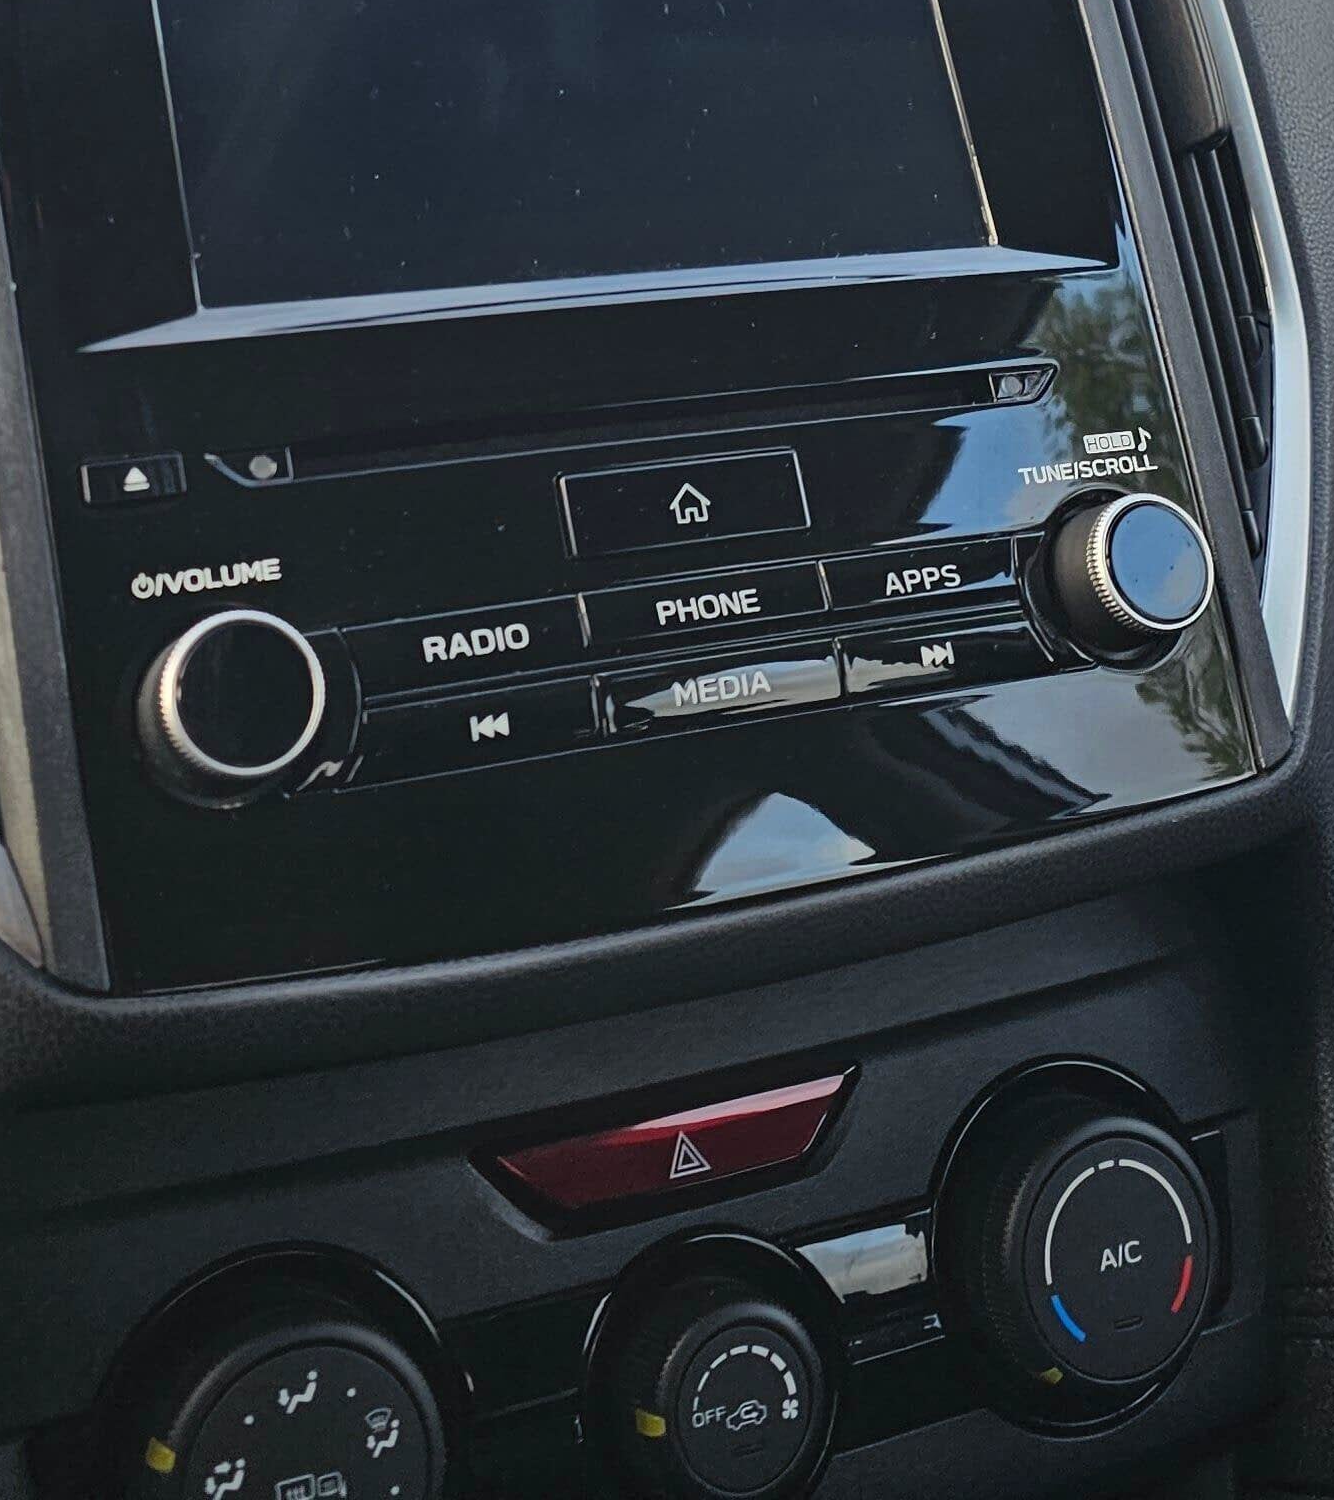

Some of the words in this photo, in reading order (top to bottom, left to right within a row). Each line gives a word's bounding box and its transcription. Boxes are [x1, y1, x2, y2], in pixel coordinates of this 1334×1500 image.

[1085, 434, 1133, 451] HOLD
[1018, 454, 1158, 485] TUNE/SCROLL
[885, 563, 961, 596] APPS
[656, 588, 760, 625] PHONE
[422, 622, 530, 663] RADIO
[672, 671, 771, 707] MEDIA
[1099, 1239, 1142, 1271] A/C
[692, 1405, 726, 1427] OFF
